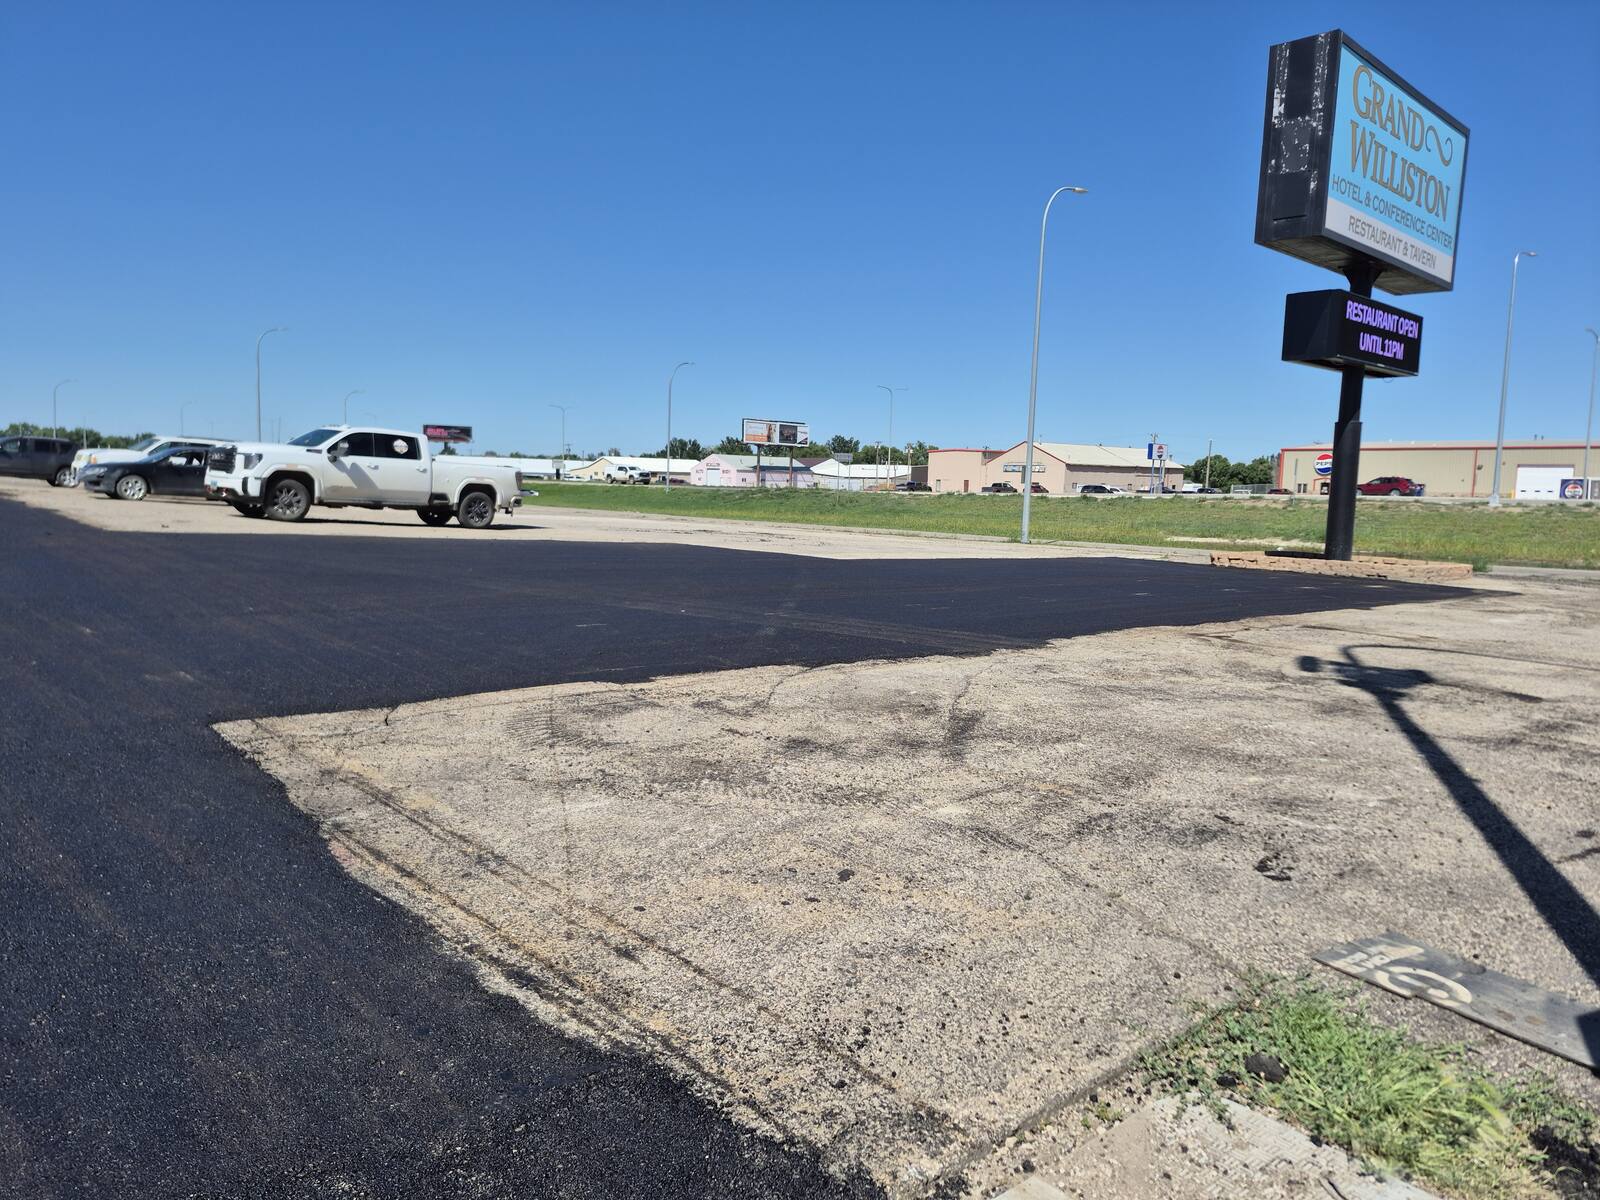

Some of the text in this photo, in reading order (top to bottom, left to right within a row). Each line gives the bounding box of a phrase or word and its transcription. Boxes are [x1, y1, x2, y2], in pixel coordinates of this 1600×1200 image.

[1352, 64, 1425, 152] GRAND
[1350, 120, 1450, 222] WILLISTON
[1331, 174, 1453, 250] HOTEL & CONFERENCE CENTER
[1348, 215, 1437, 269] RESTAURANT & TAVERN
[1345, 299, 1419, 340] RESTAURANT OPEN
[1359, 331, 1405, 360] UNTIL 11PM
